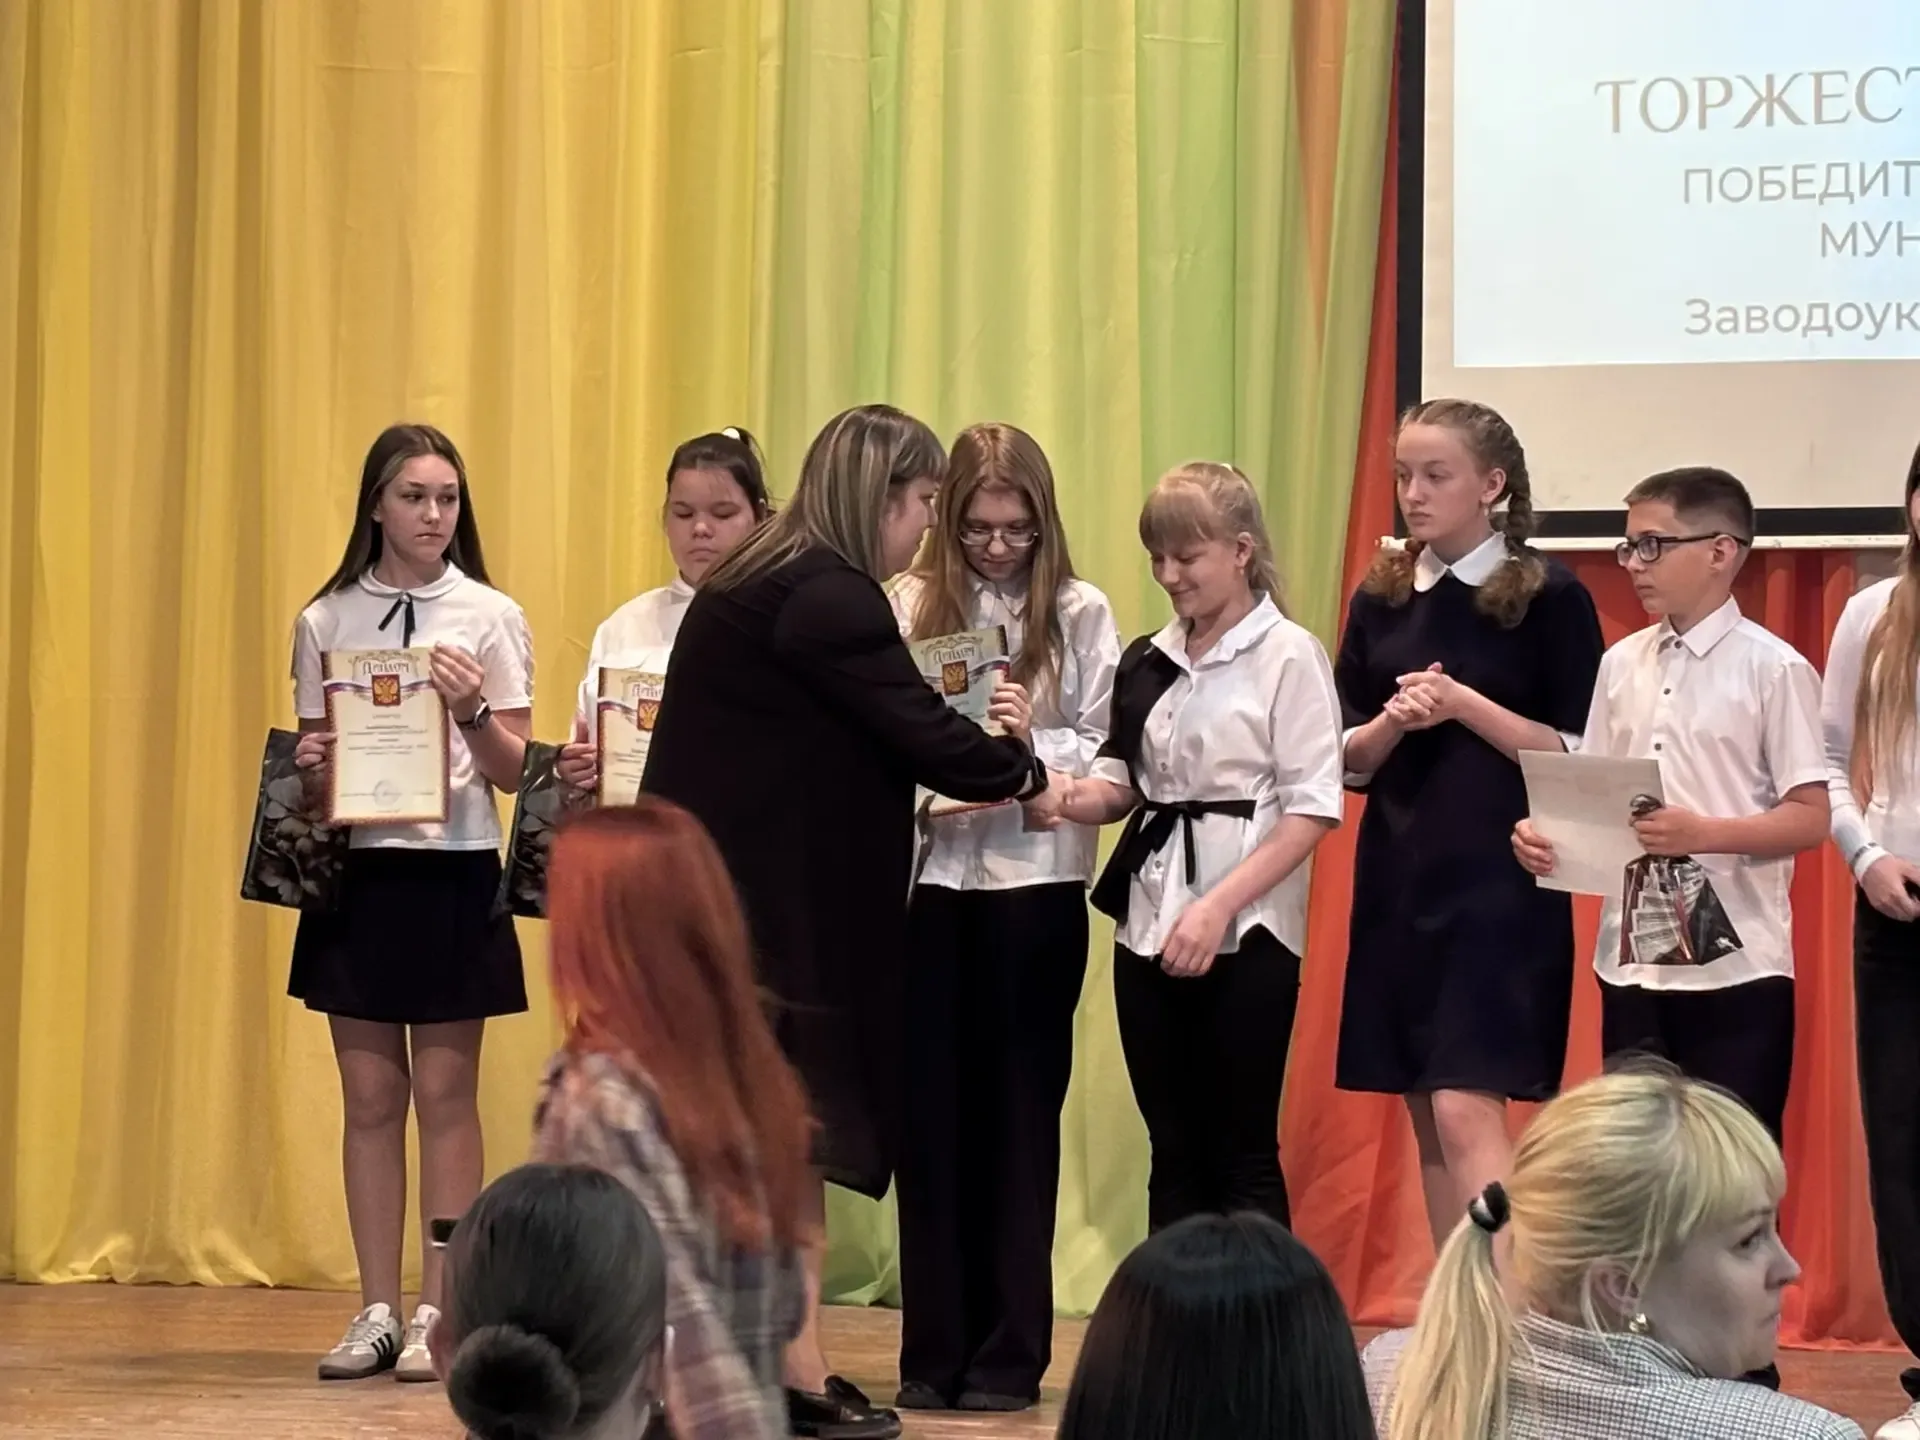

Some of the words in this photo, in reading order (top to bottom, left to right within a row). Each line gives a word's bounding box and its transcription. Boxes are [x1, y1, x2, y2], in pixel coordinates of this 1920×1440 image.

[1684, 160, 1920, 206] ПОБЕДИТ
[1821, 220, 1920, 258] МУН
[1684, 298, 1920, 341] Заводоук
